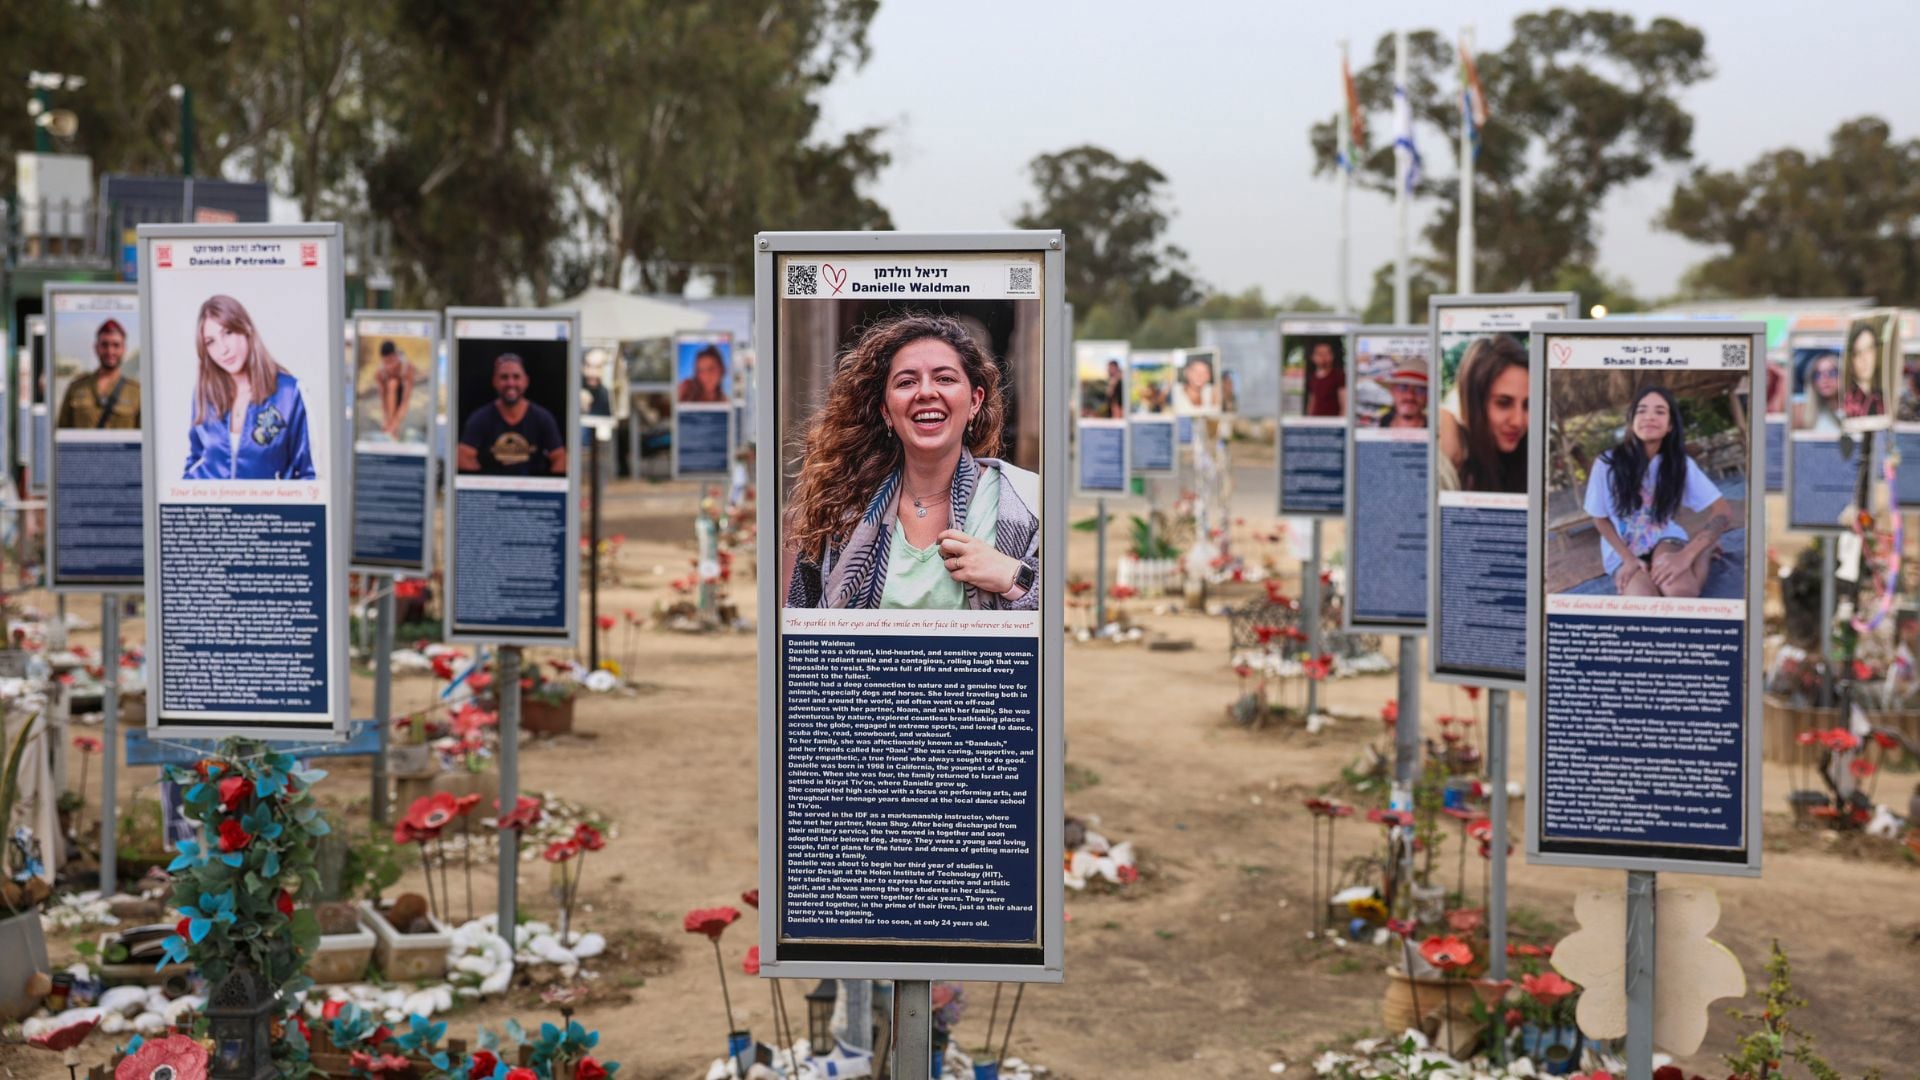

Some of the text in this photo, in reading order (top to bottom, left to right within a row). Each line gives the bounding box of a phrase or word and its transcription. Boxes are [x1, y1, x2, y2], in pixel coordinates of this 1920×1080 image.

[190, 257, 285, 266] Daniela Petrenko
[874, 267, 948, 279] דניאל וולדמן
[852, 283, 970, 292] Danielle Waldman
[803, 618, 826, 629] sparkle
[850, 621, 864, 630] eyes
[922, 619, 933, 628] her
[935, 620, 948, 630] face
[971, 620, 999, 628] wherever
[1001, 620, 1012, 628] she
[901, 657, 945, 665] contagious,
[947, 658, 971, 666] rolling
[973, 658, 994, 666] laugh
[788, 664, 829, 672] impossible
[843, 681, 862, 689] deep
[967, 682, 997, 690] genuine
[870, 861, 892, 869] begin
[817, 868, 843, 876] Design
[937, 870, 980, 878] Technology
[923, 919, 939, 927] only
